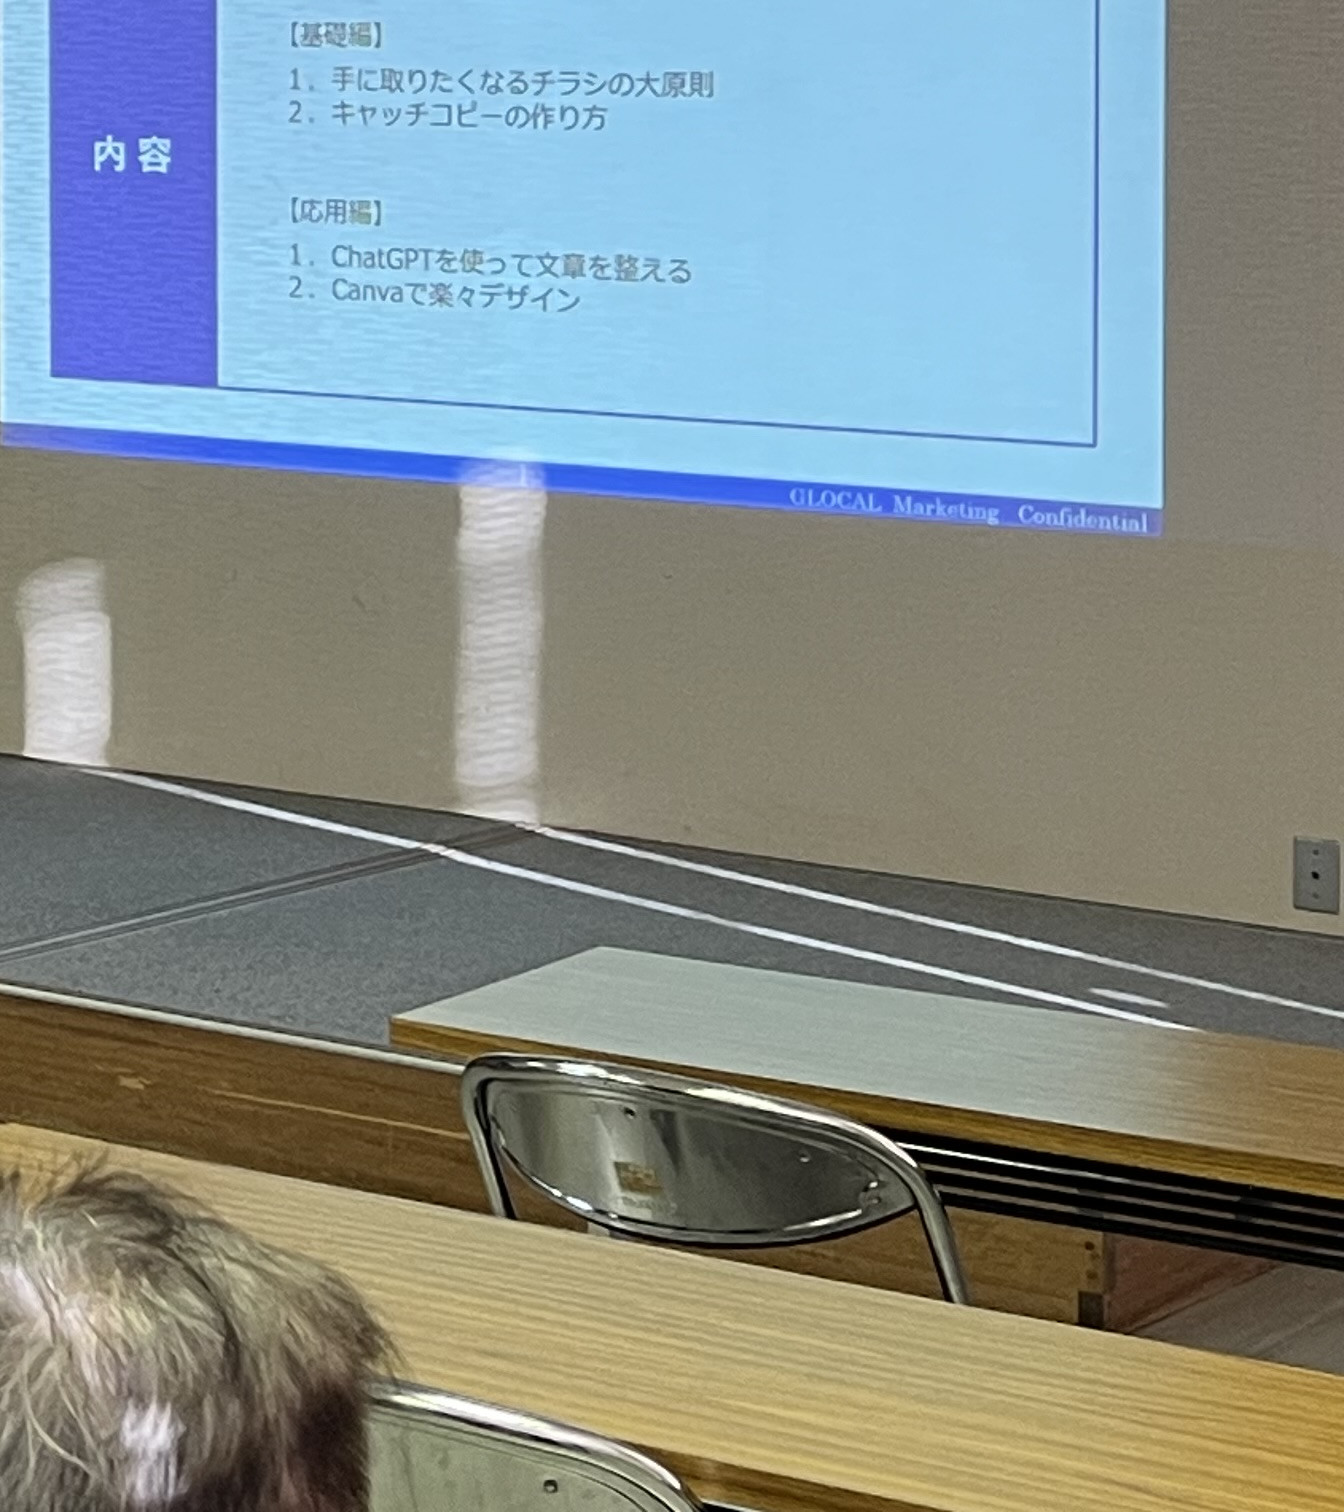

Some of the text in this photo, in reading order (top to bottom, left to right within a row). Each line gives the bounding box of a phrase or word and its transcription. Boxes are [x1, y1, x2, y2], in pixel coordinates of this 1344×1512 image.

[789, 487, 1149, 534] GLOCAL Marketing Confidential
